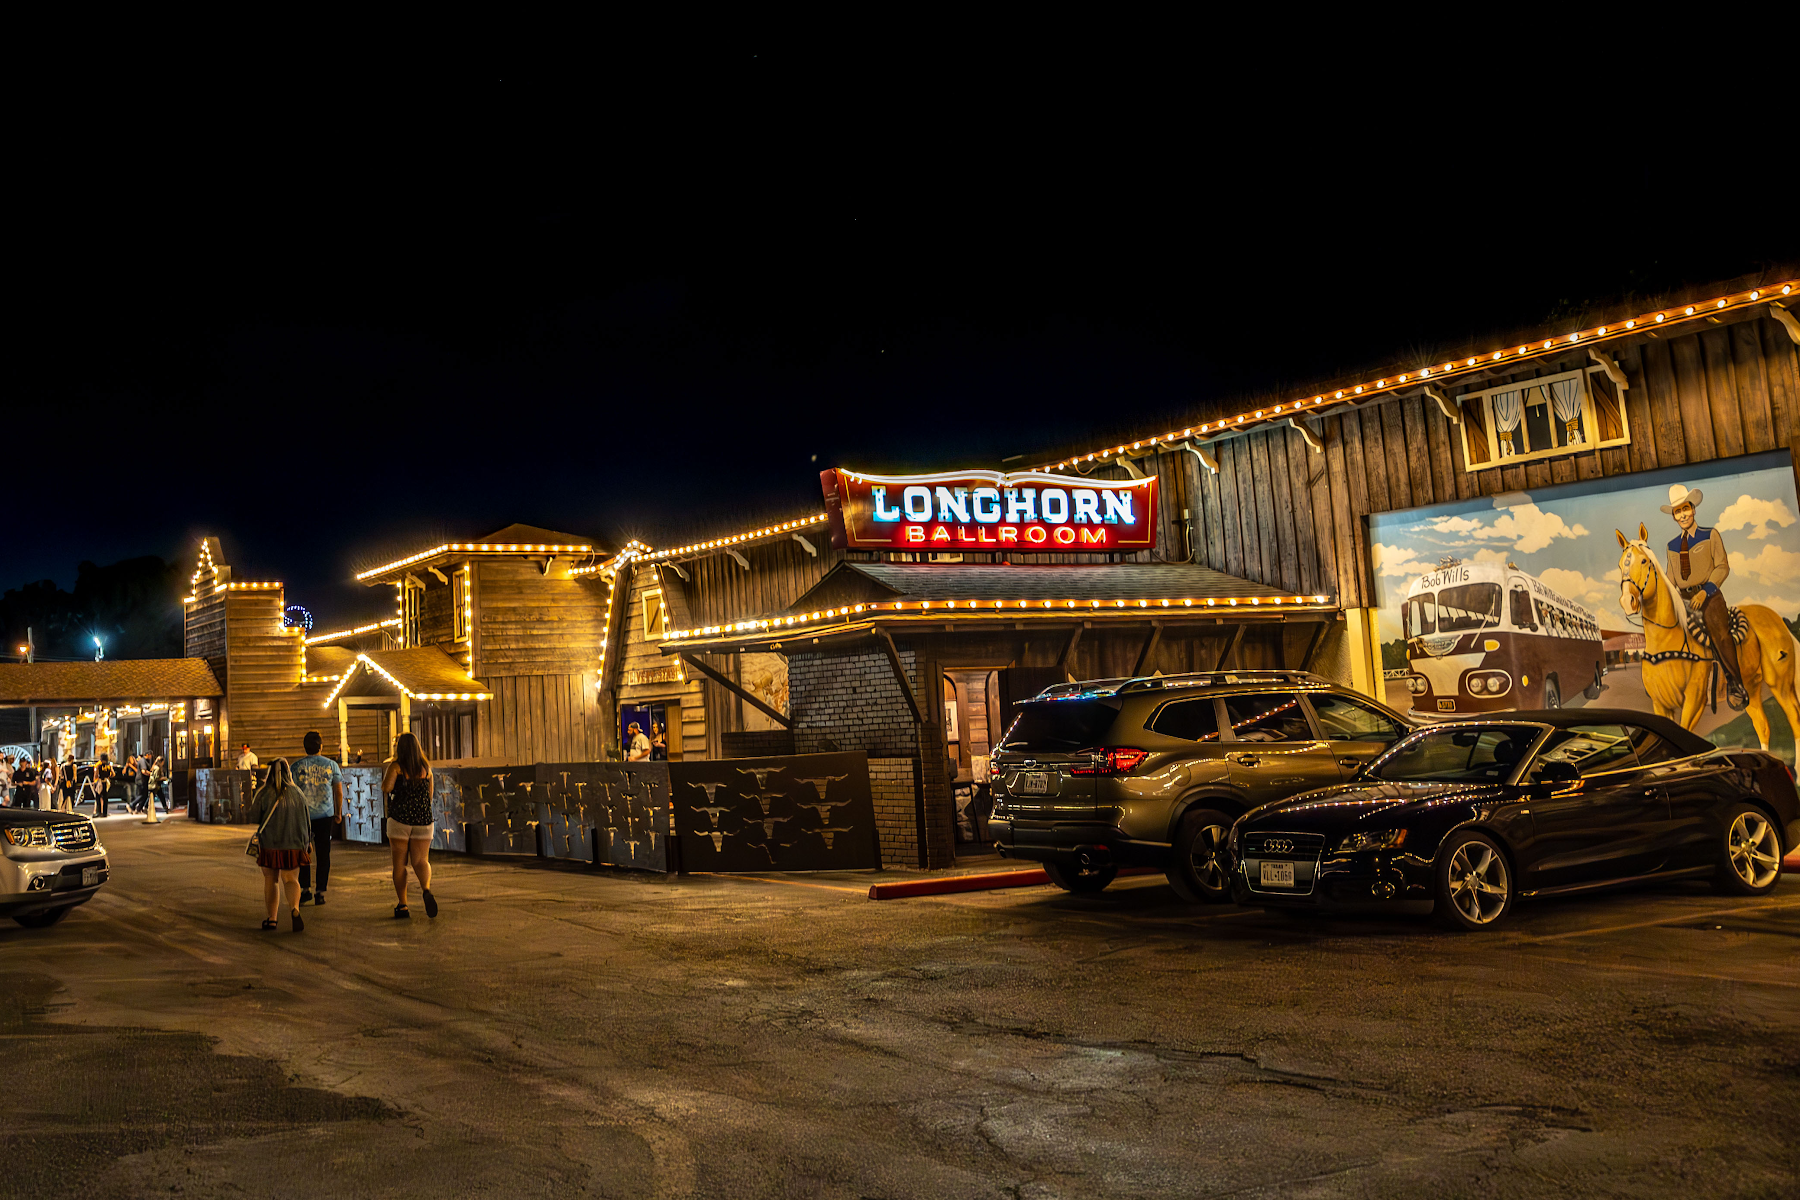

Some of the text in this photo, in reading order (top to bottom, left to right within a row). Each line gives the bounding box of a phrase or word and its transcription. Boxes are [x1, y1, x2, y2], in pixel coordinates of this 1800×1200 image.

[871, 485, 1136, 524] LONGHORN
[905, 526, 1107, 544] BALLROOM
[1421, 567, 1470, 589] Bob Wills
